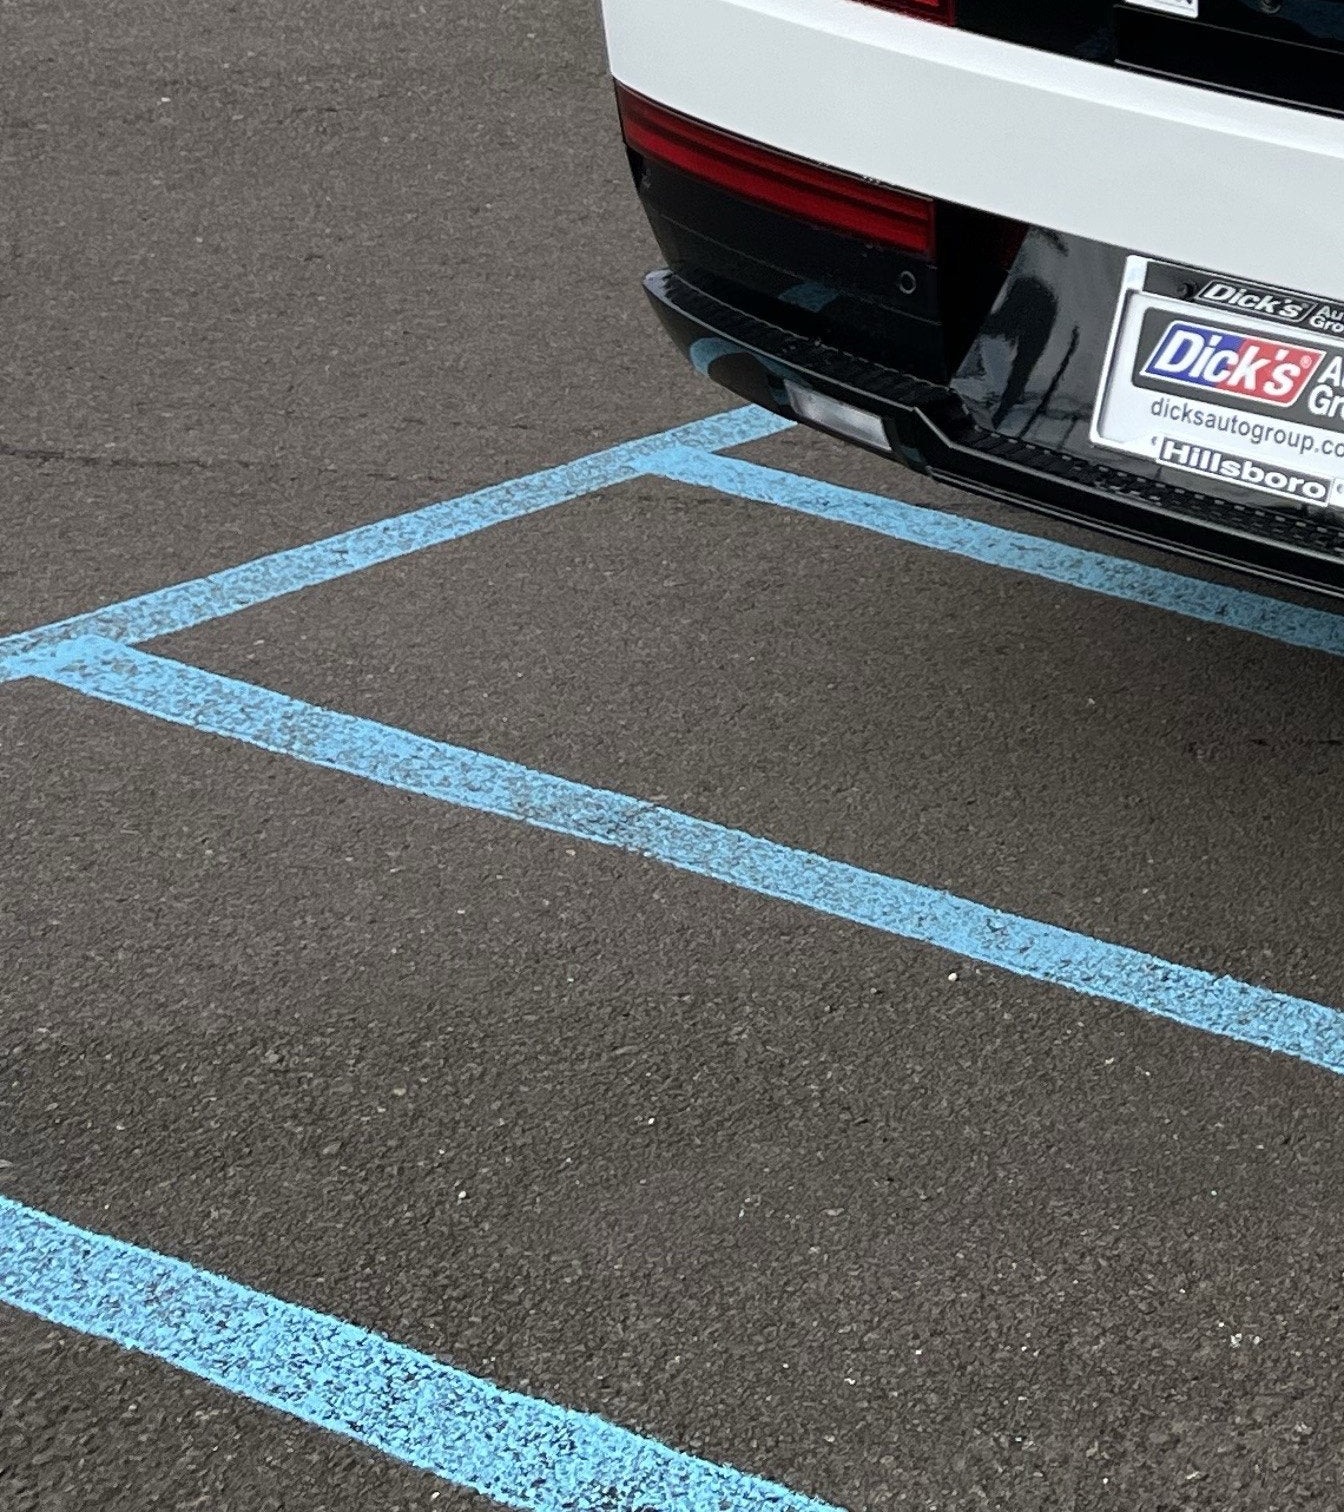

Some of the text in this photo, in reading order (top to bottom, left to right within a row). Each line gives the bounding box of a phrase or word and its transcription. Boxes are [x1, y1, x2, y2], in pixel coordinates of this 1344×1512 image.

[1203, 283, 1303, 319] Dick's
[1153, 330, 1301, 399] Dick's
[1159, 437, 1328, 502] Hillsboro
